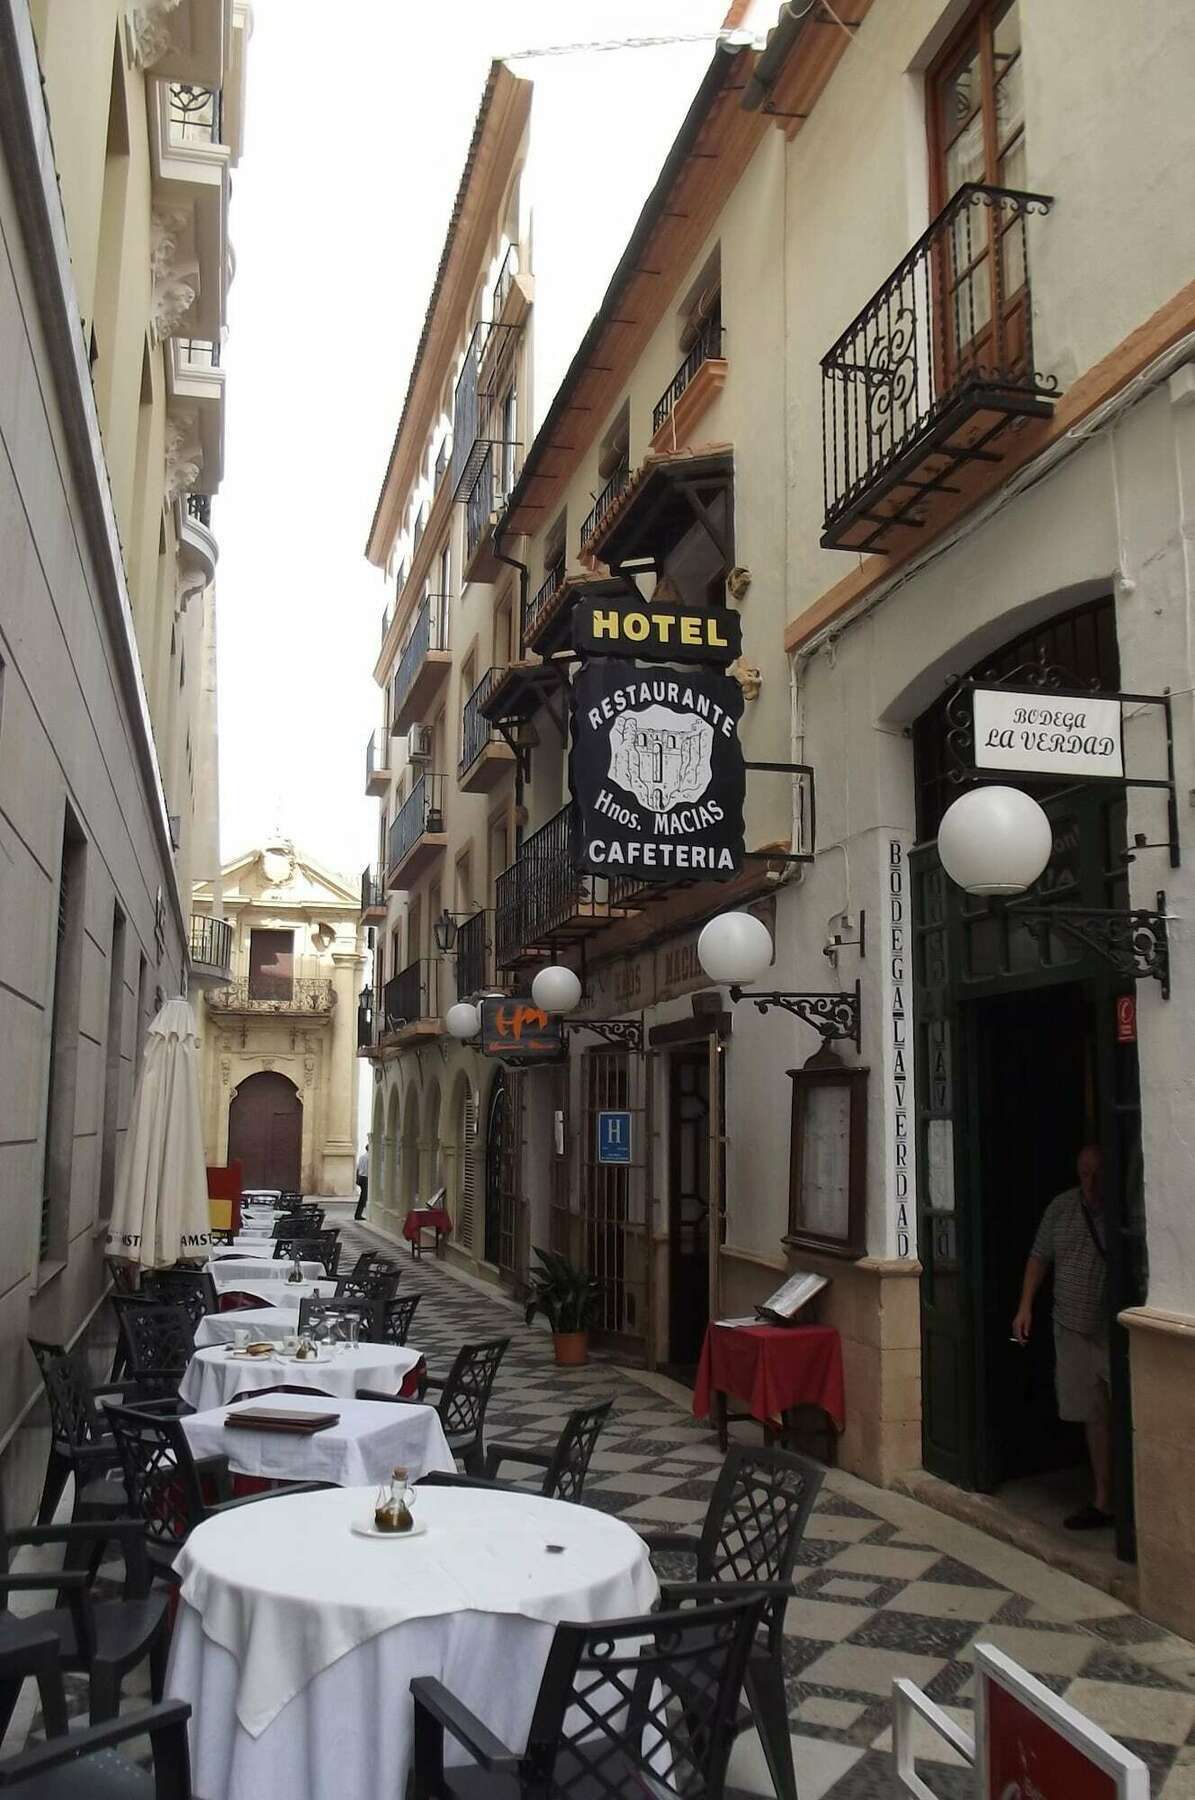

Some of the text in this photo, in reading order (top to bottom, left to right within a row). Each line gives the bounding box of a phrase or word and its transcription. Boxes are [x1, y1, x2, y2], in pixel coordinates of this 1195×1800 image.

[592, 610, 728, 647] HOTEL
[588, 681, 735, 738] RESTAURANTE
[1012, 707, 1087, 733] BODEGA
[984, 728, 1115, 756] LA VERDAD
[594, 789, 724, 836] Hnos. MACIAS
[588, 839, 735, 870] CAFETERIA
[890, 842, 903, 1009] BODEGA
[607, 1119, 621, 1144] H
[895, 1084, 909, 1257] VERDAD
